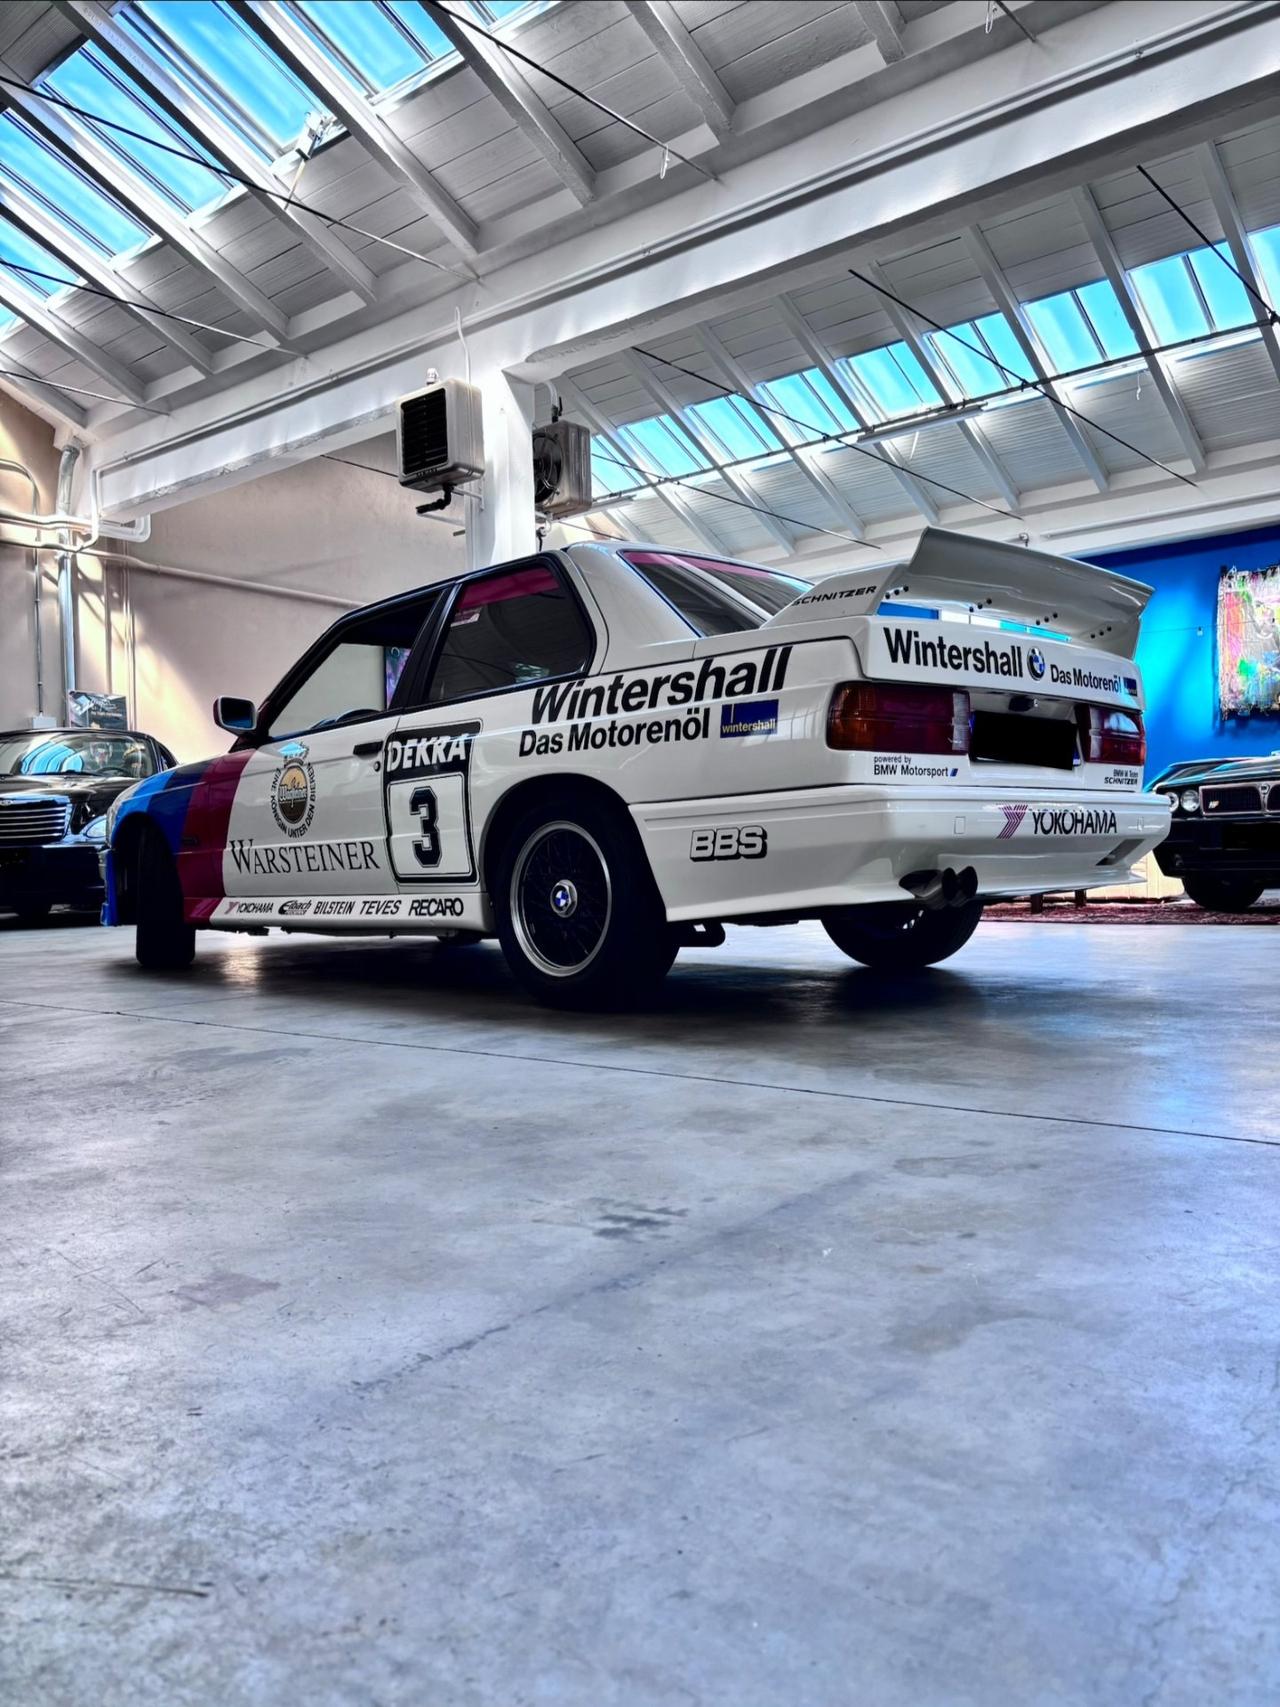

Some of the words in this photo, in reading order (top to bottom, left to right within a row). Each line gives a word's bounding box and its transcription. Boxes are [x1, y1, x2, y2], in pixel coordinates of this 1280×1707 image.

[792, 586, 877, 606] SCHNITZER
[883, 627, 1023, 678] Wintershall
[532, 646, 793, 724] Wintershall
[1050, 664, 1072, 685] Das
[1073, 667, 1122, 694] Motorenöl
[519, 729, 563, 757] Das
[567, 707, 711, 751] Motorenöl
[722, 718, 776, 733] wintershall
[386, 733, 467, 772] DEKRA
[904, 755, 912, 764] by
[874, 764, 897, 775] BMW
[901, 765, 948, 778] Motorsport
[304, 804, 315, 827] DEN
[409, 786, 442, 868] 3
[1031, 809, 1117, 834] YOKOHAMA
[690, 825, 767, 862] BBS
[313, 901, 355, 914] BILSTEIN
[360, 900, 402, 914] TEVES
[408, 897, 464, 916] RECARO
